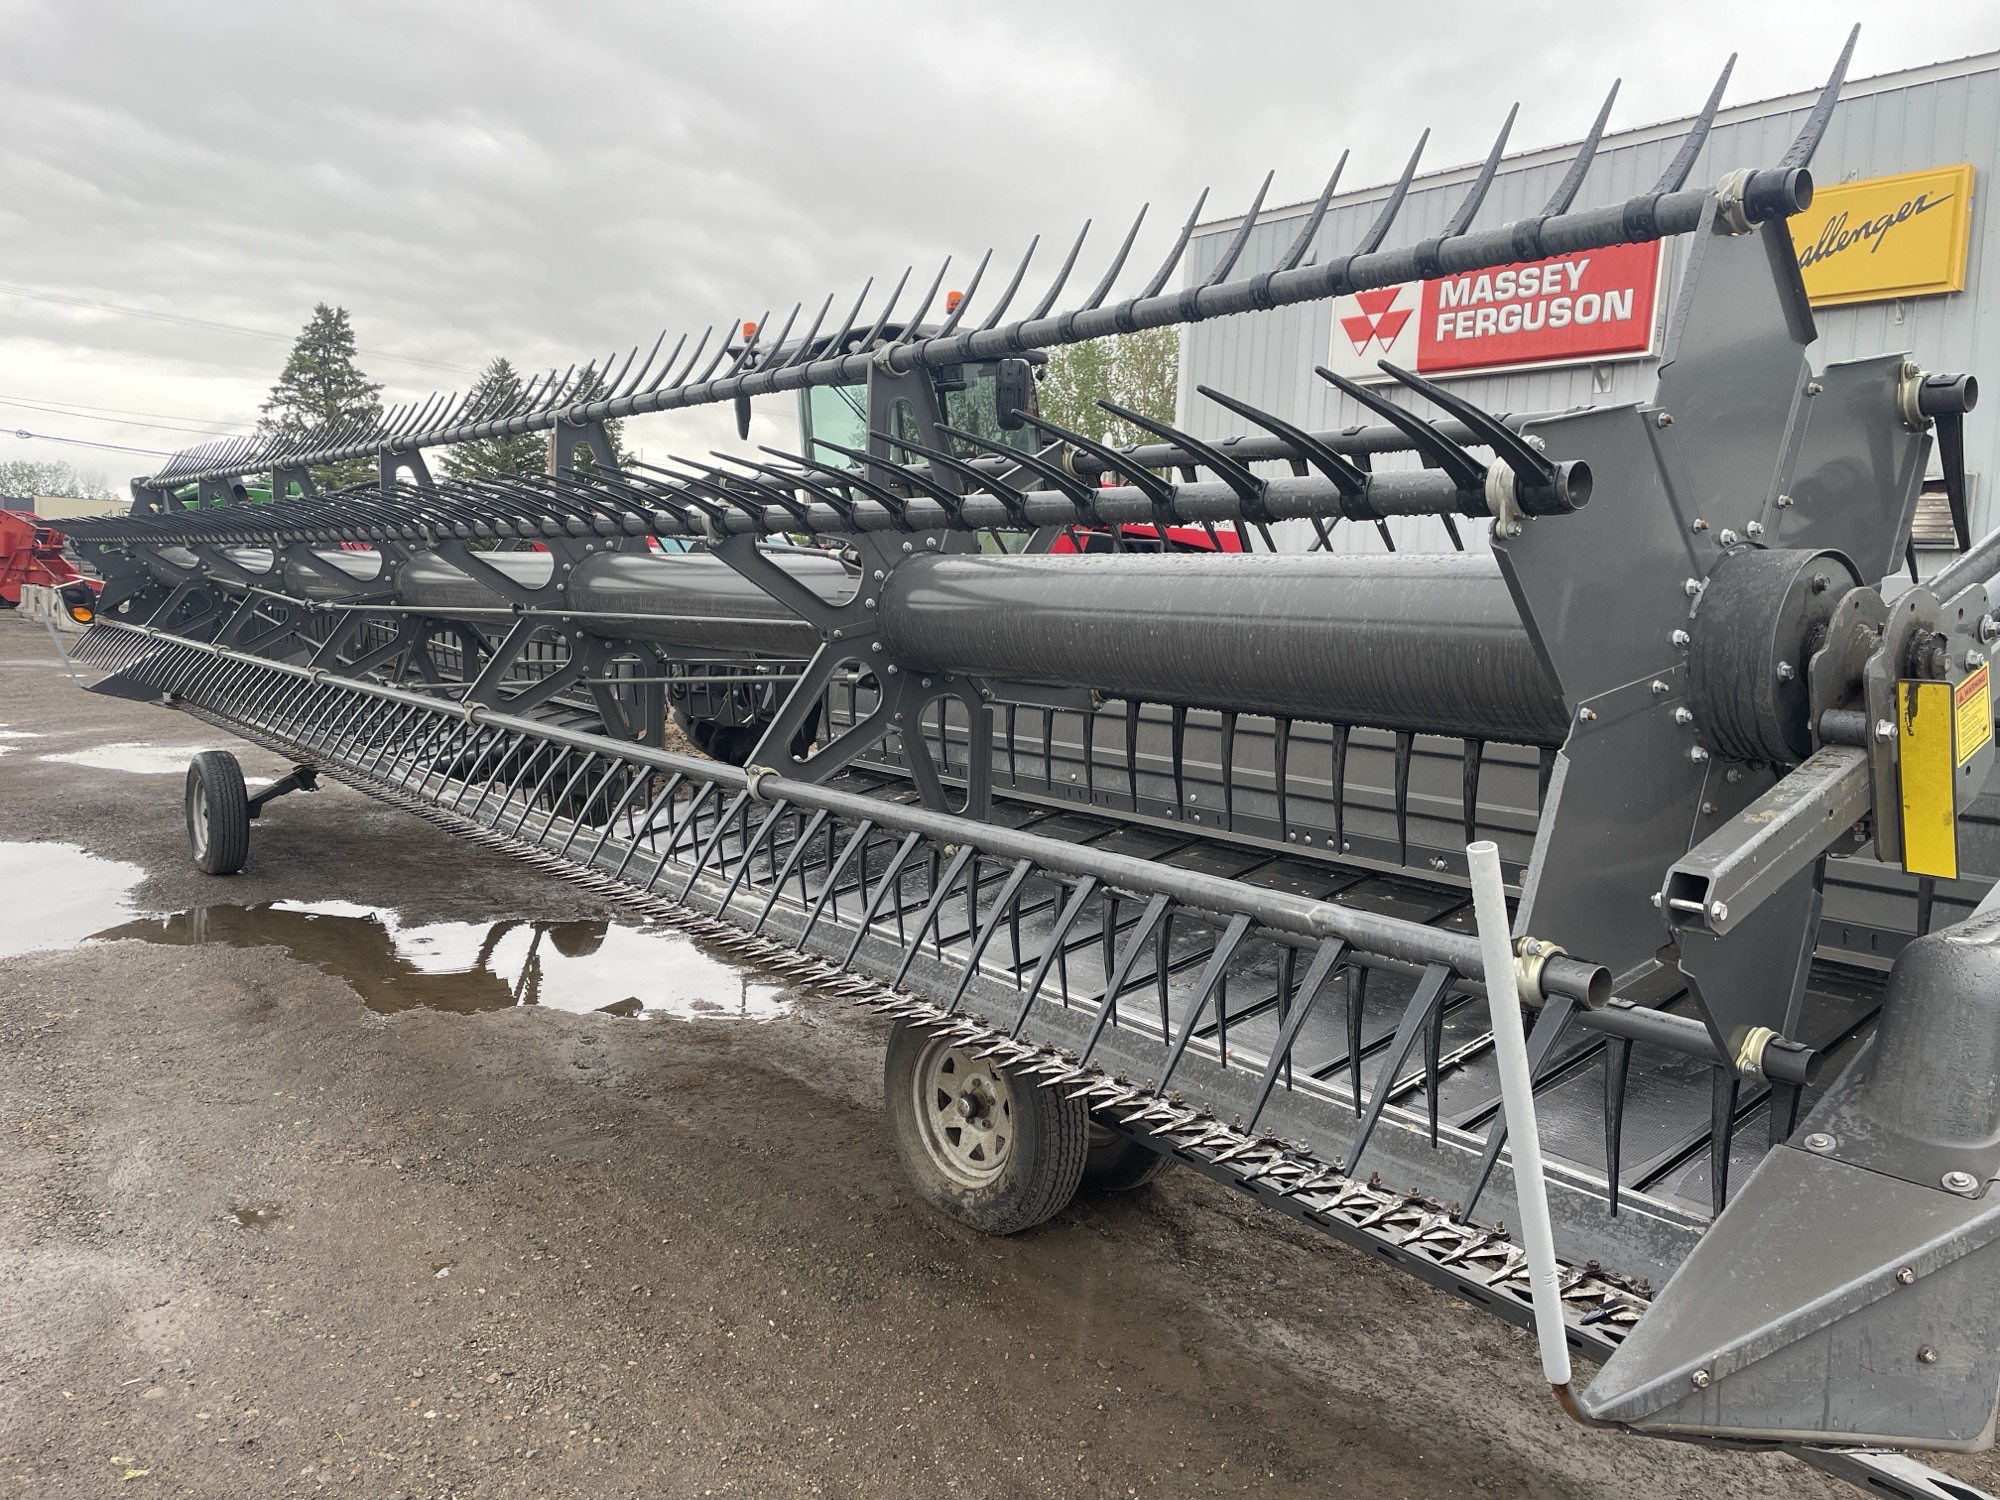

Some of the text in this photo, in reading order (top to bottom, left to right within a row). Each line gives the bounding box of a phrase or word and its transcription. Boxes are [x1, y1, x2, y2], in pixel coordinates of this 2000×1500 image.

[1799, 192, 1954, 269] allenger
[1438, 259, 1590, 310] MASSEY
[1436, 288, 1634, 342] FERGUSON
[1964, 674, 1986, 697] WARNING
